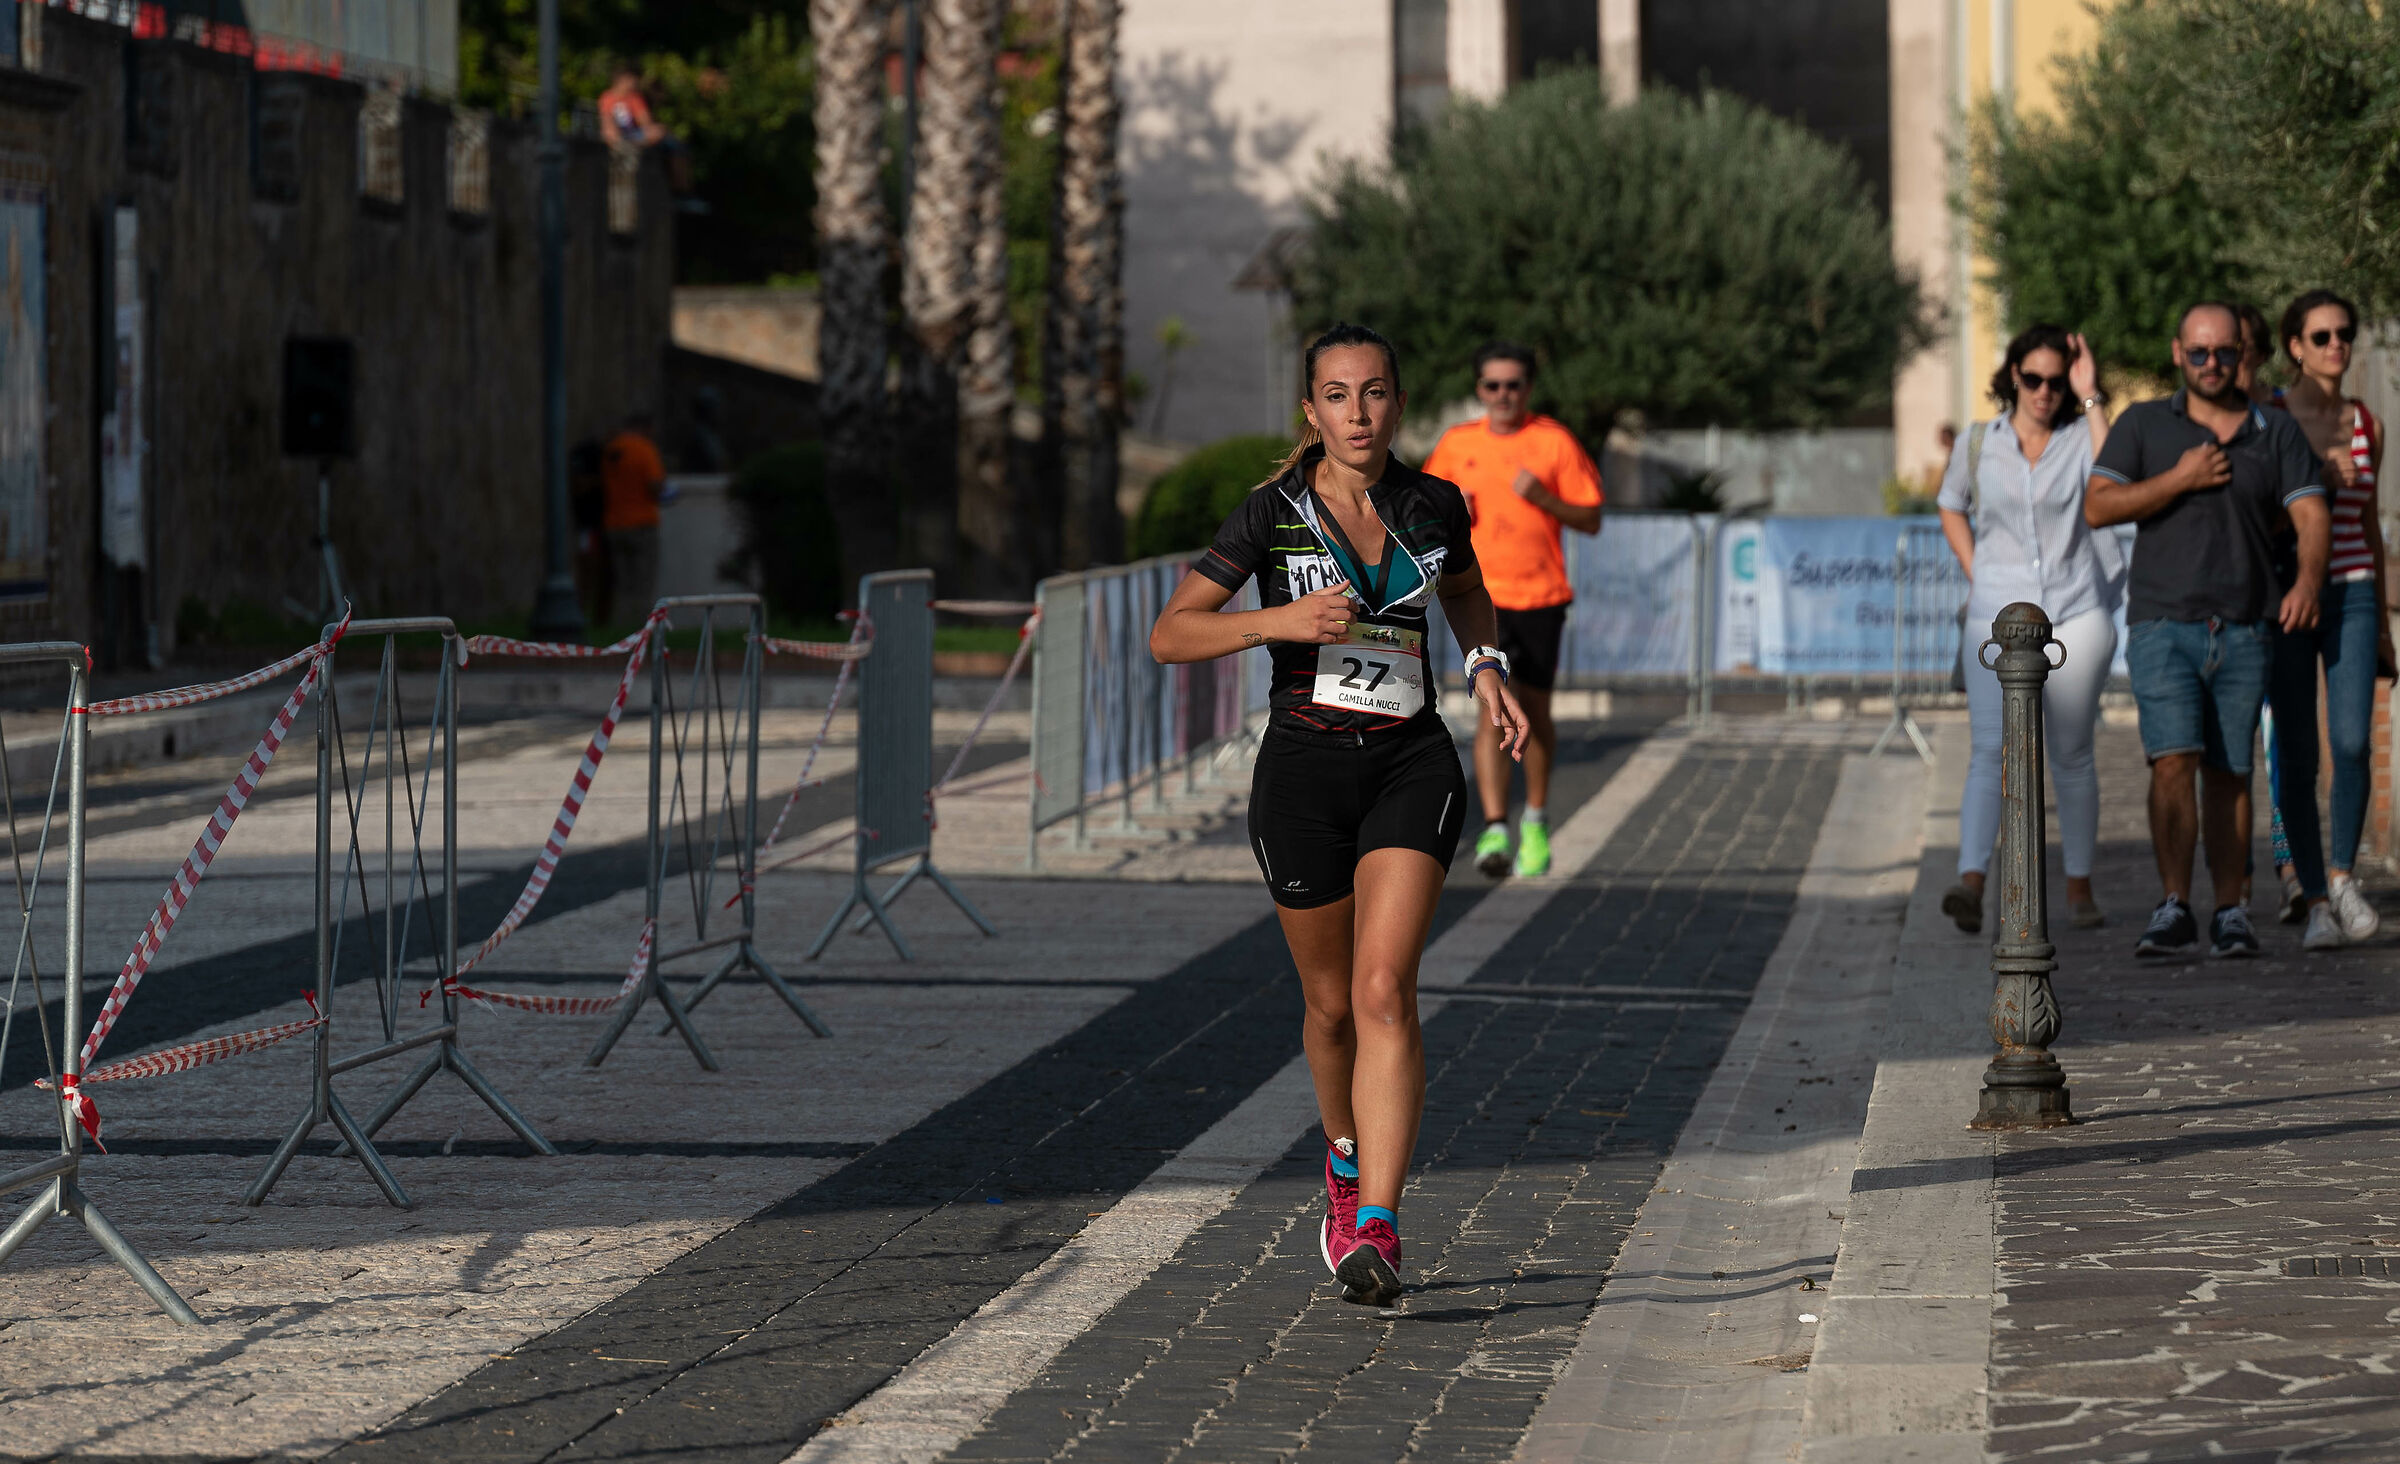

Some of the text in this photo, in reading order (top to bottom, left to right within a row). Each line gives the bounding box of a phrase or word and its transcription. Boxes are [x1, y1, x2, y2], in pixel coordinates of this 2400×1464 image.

[1339, 657, 1391, 693] 27
[1338, 692, 1401, 712] CAMILLA NUCCI
